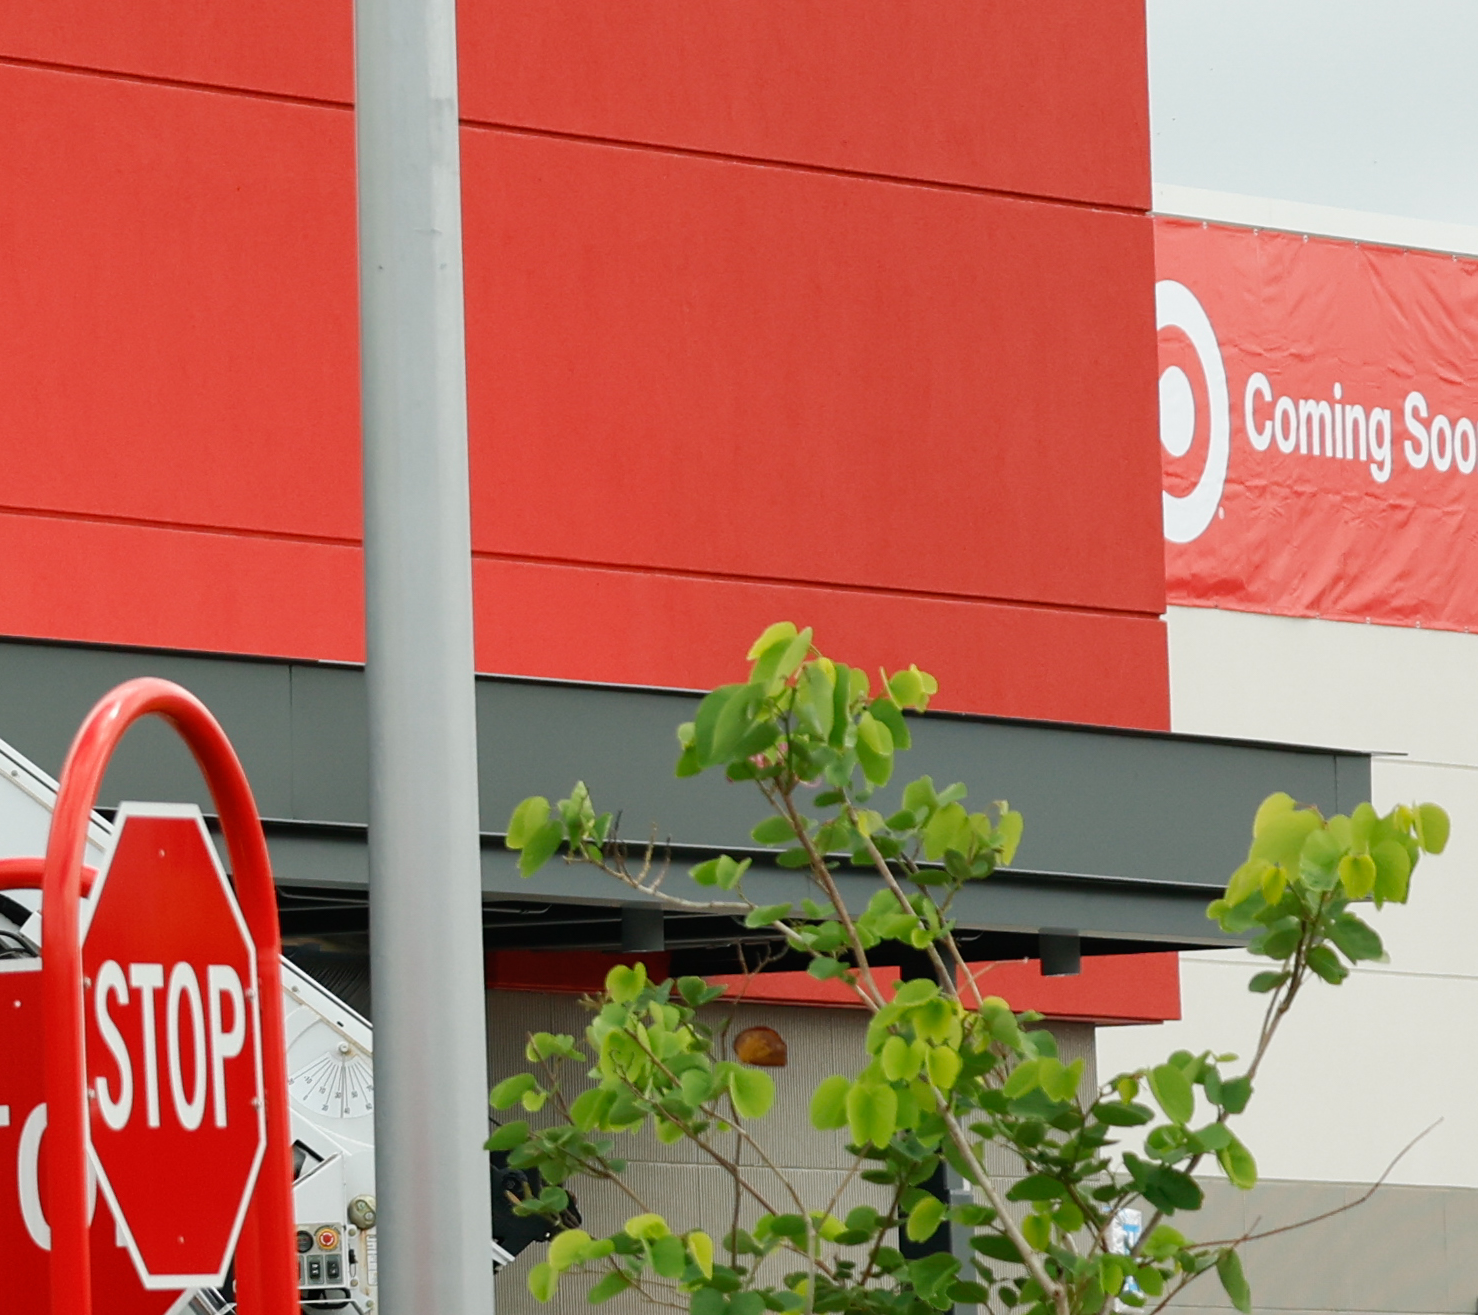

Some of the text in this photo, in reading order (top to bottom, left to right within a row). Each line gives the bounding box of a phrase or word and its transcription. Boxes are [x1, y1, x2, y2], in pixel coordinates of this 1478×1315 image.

[1244, 371, 1478, 484] Coming Soo
[94, 960, 246, 1131] STOP
